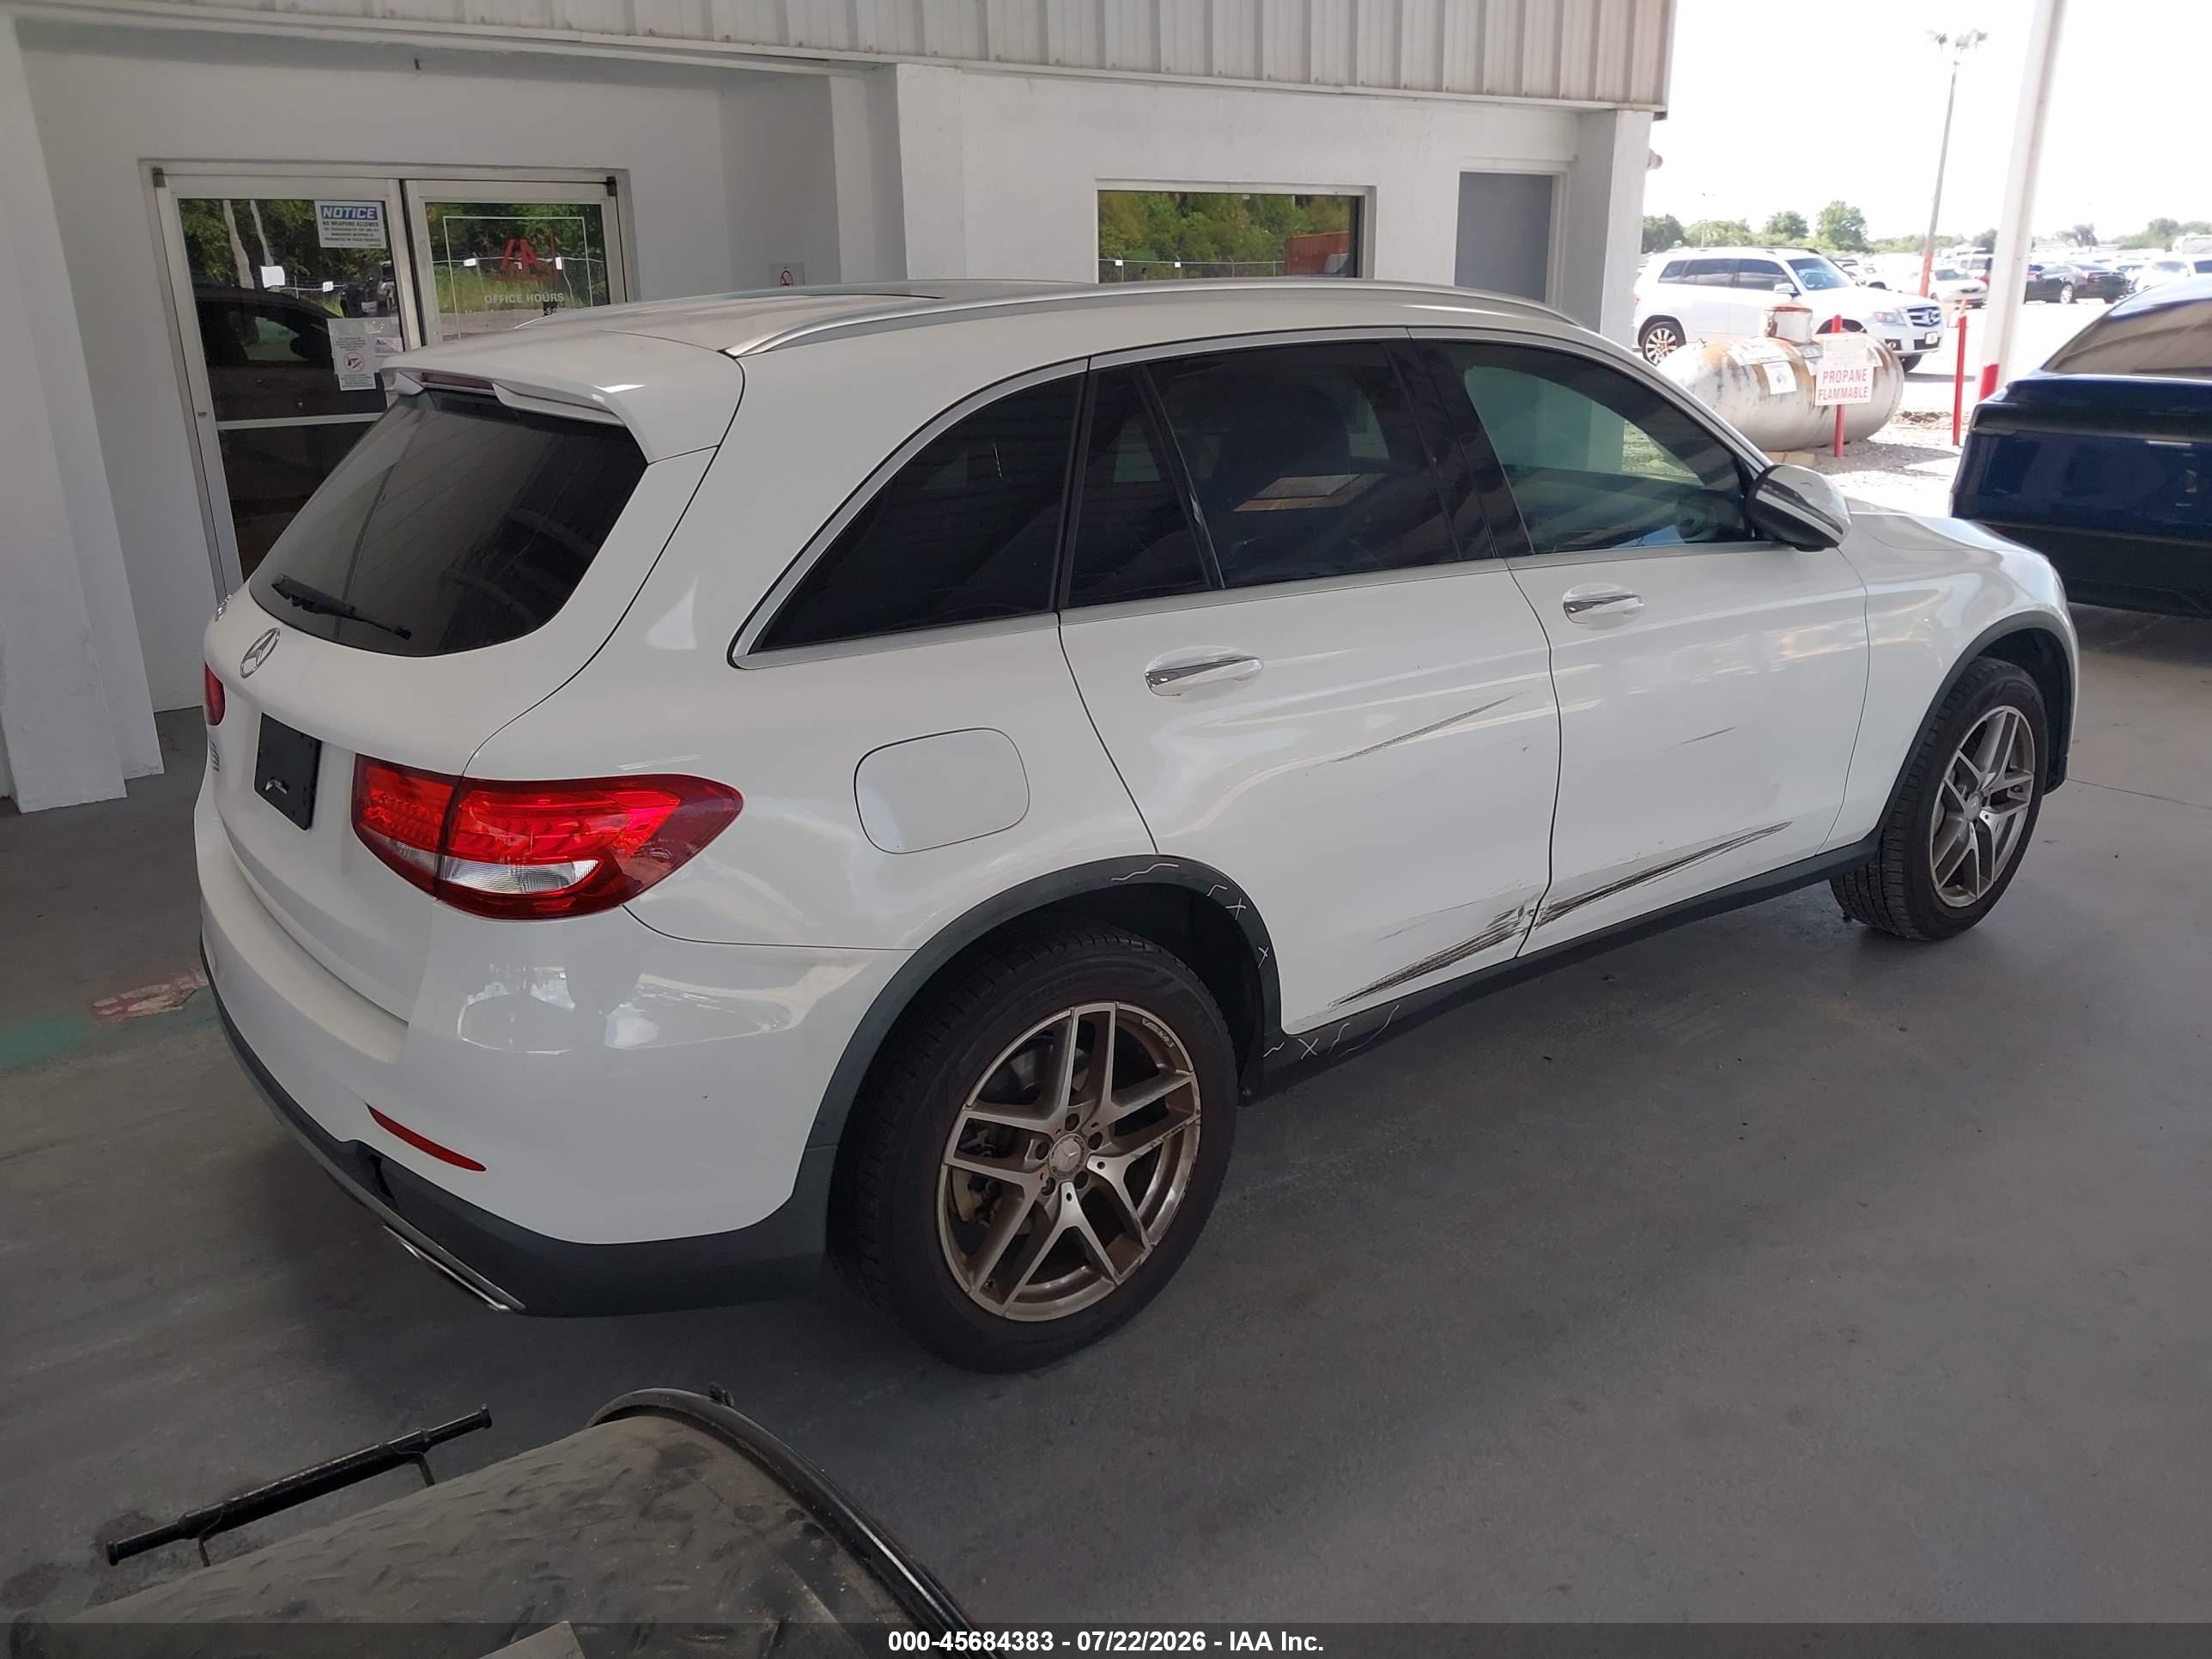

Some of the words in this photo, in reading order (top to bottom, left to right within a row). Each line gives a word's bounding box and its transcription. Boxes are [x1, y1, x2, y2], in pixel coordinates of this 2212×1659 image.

[322, 207, 376, 219] NOTICE
[484, 295, 523, 304] OFFICE
[526, 293, 565, 303] HOURS
[1822, 368, 1869, 384] PROPANE
[1818, 386, 1869, 401] FLAMMABLE
